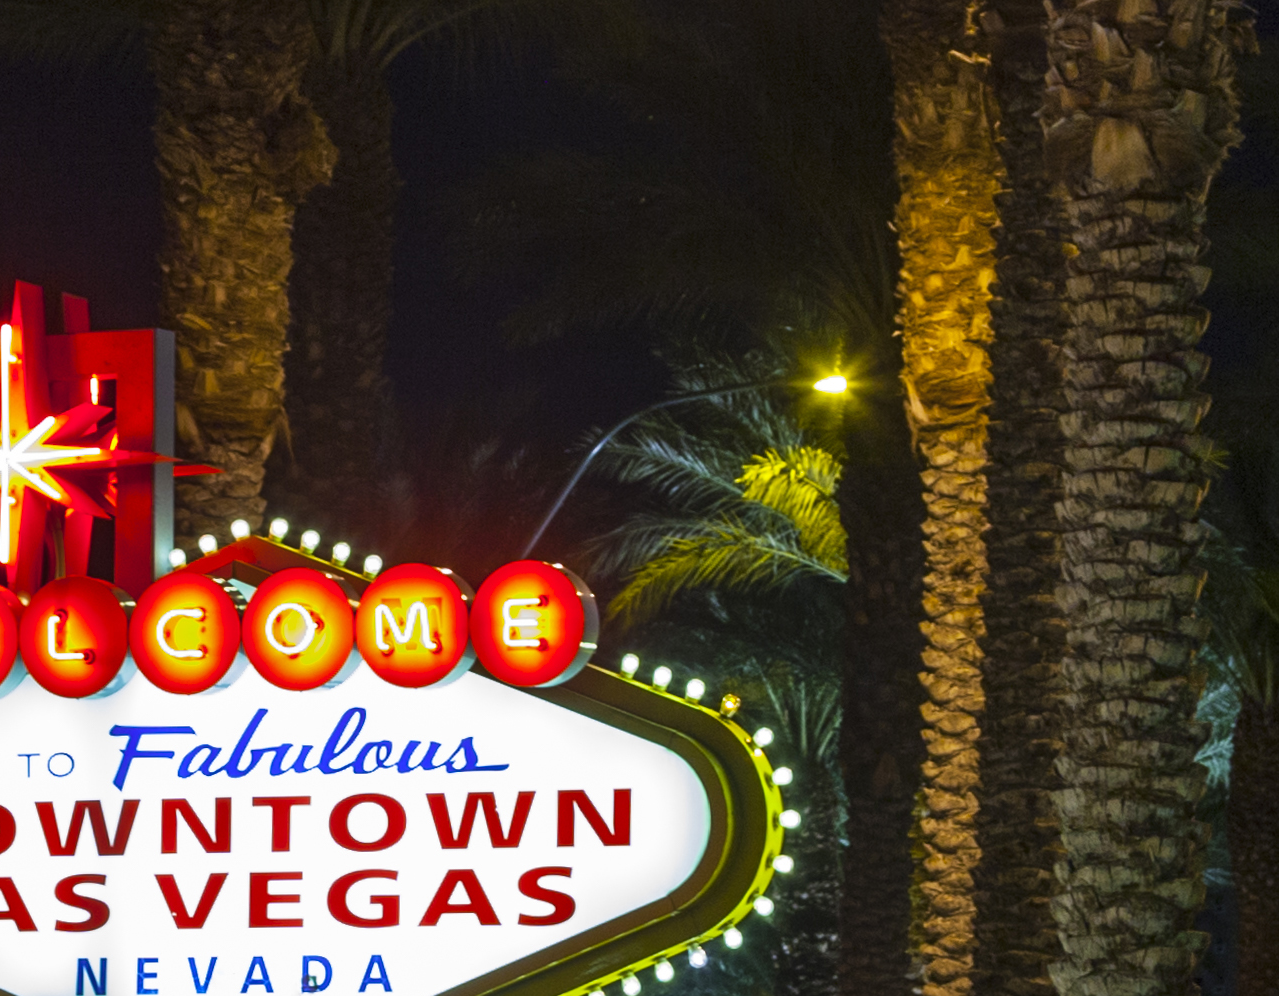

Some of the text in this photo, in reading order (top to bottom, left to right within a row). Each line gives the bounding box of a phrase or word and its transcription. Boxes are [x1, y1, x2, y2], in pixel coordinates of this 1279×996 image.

[17, 706, 510, 791] TO Fabulous
[154, 865, 577, 930] VEGAS
[75, 954, 393, 996] NEVADA
